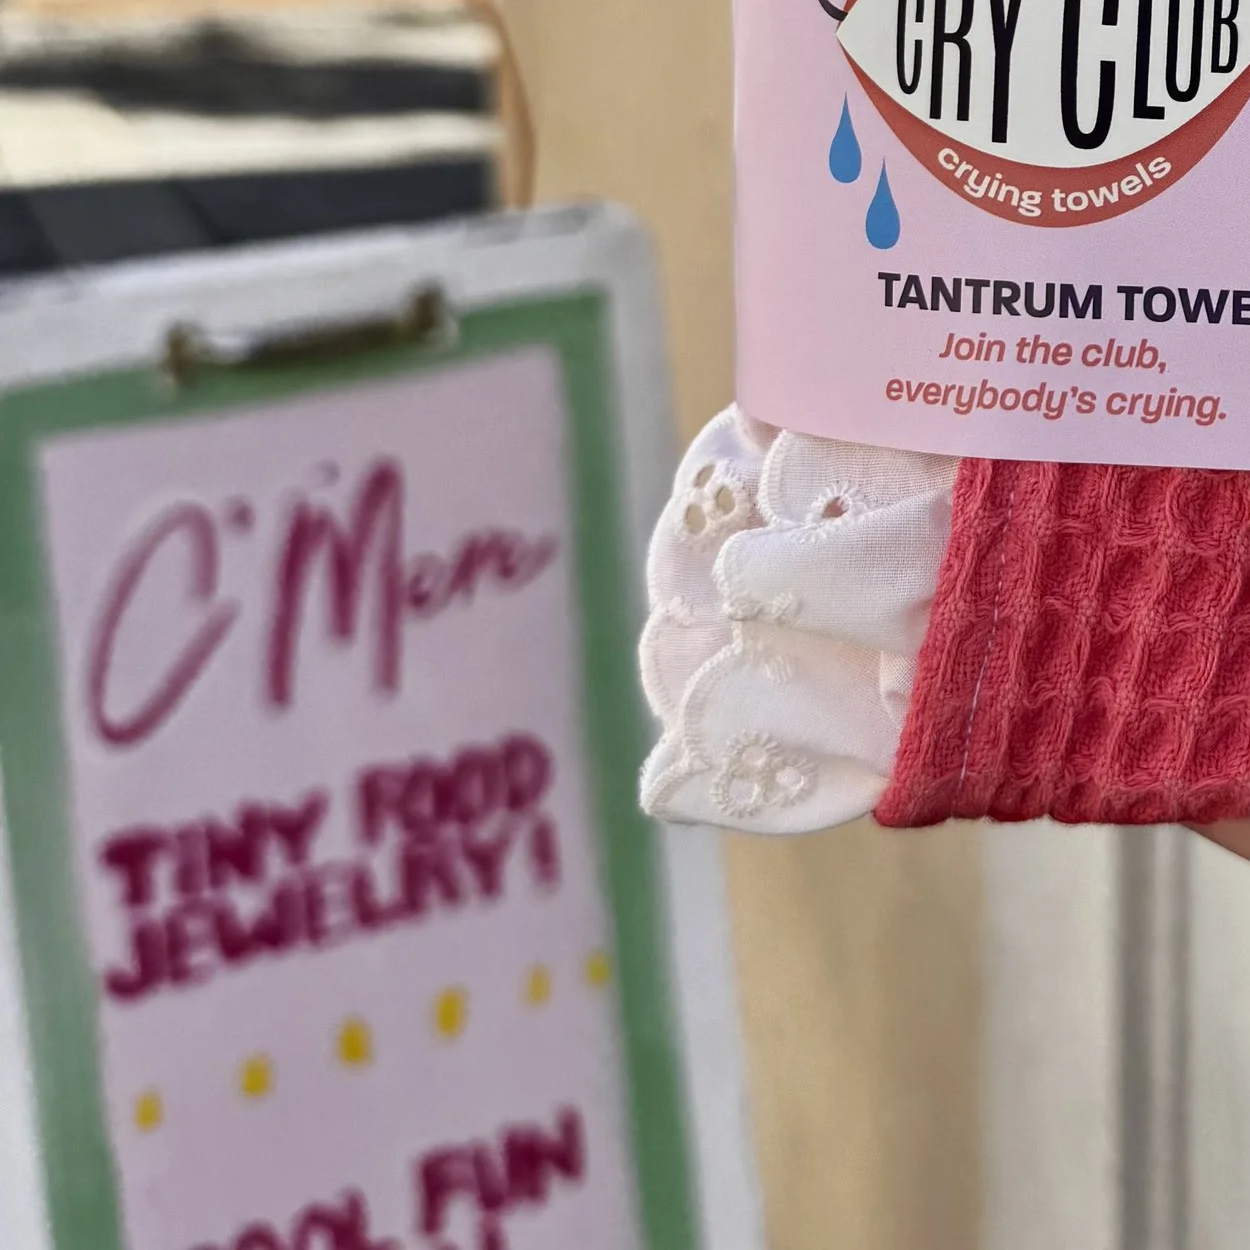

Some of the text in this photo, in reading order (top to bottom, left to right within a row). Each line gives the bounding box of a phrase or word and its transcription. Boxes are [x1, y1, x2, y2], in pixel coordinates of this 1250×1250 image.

[937, 147, 1172, 217] crying towels
[877, 271, 1102, 320] TANTRUM
[939, 332, 1168, 374] Join the club,
[885, 378, 1227, 427] everybody's crying.
[102, 733, 553, 908] TINY FOOD
[415, 1105, 585, 1238] FUN
